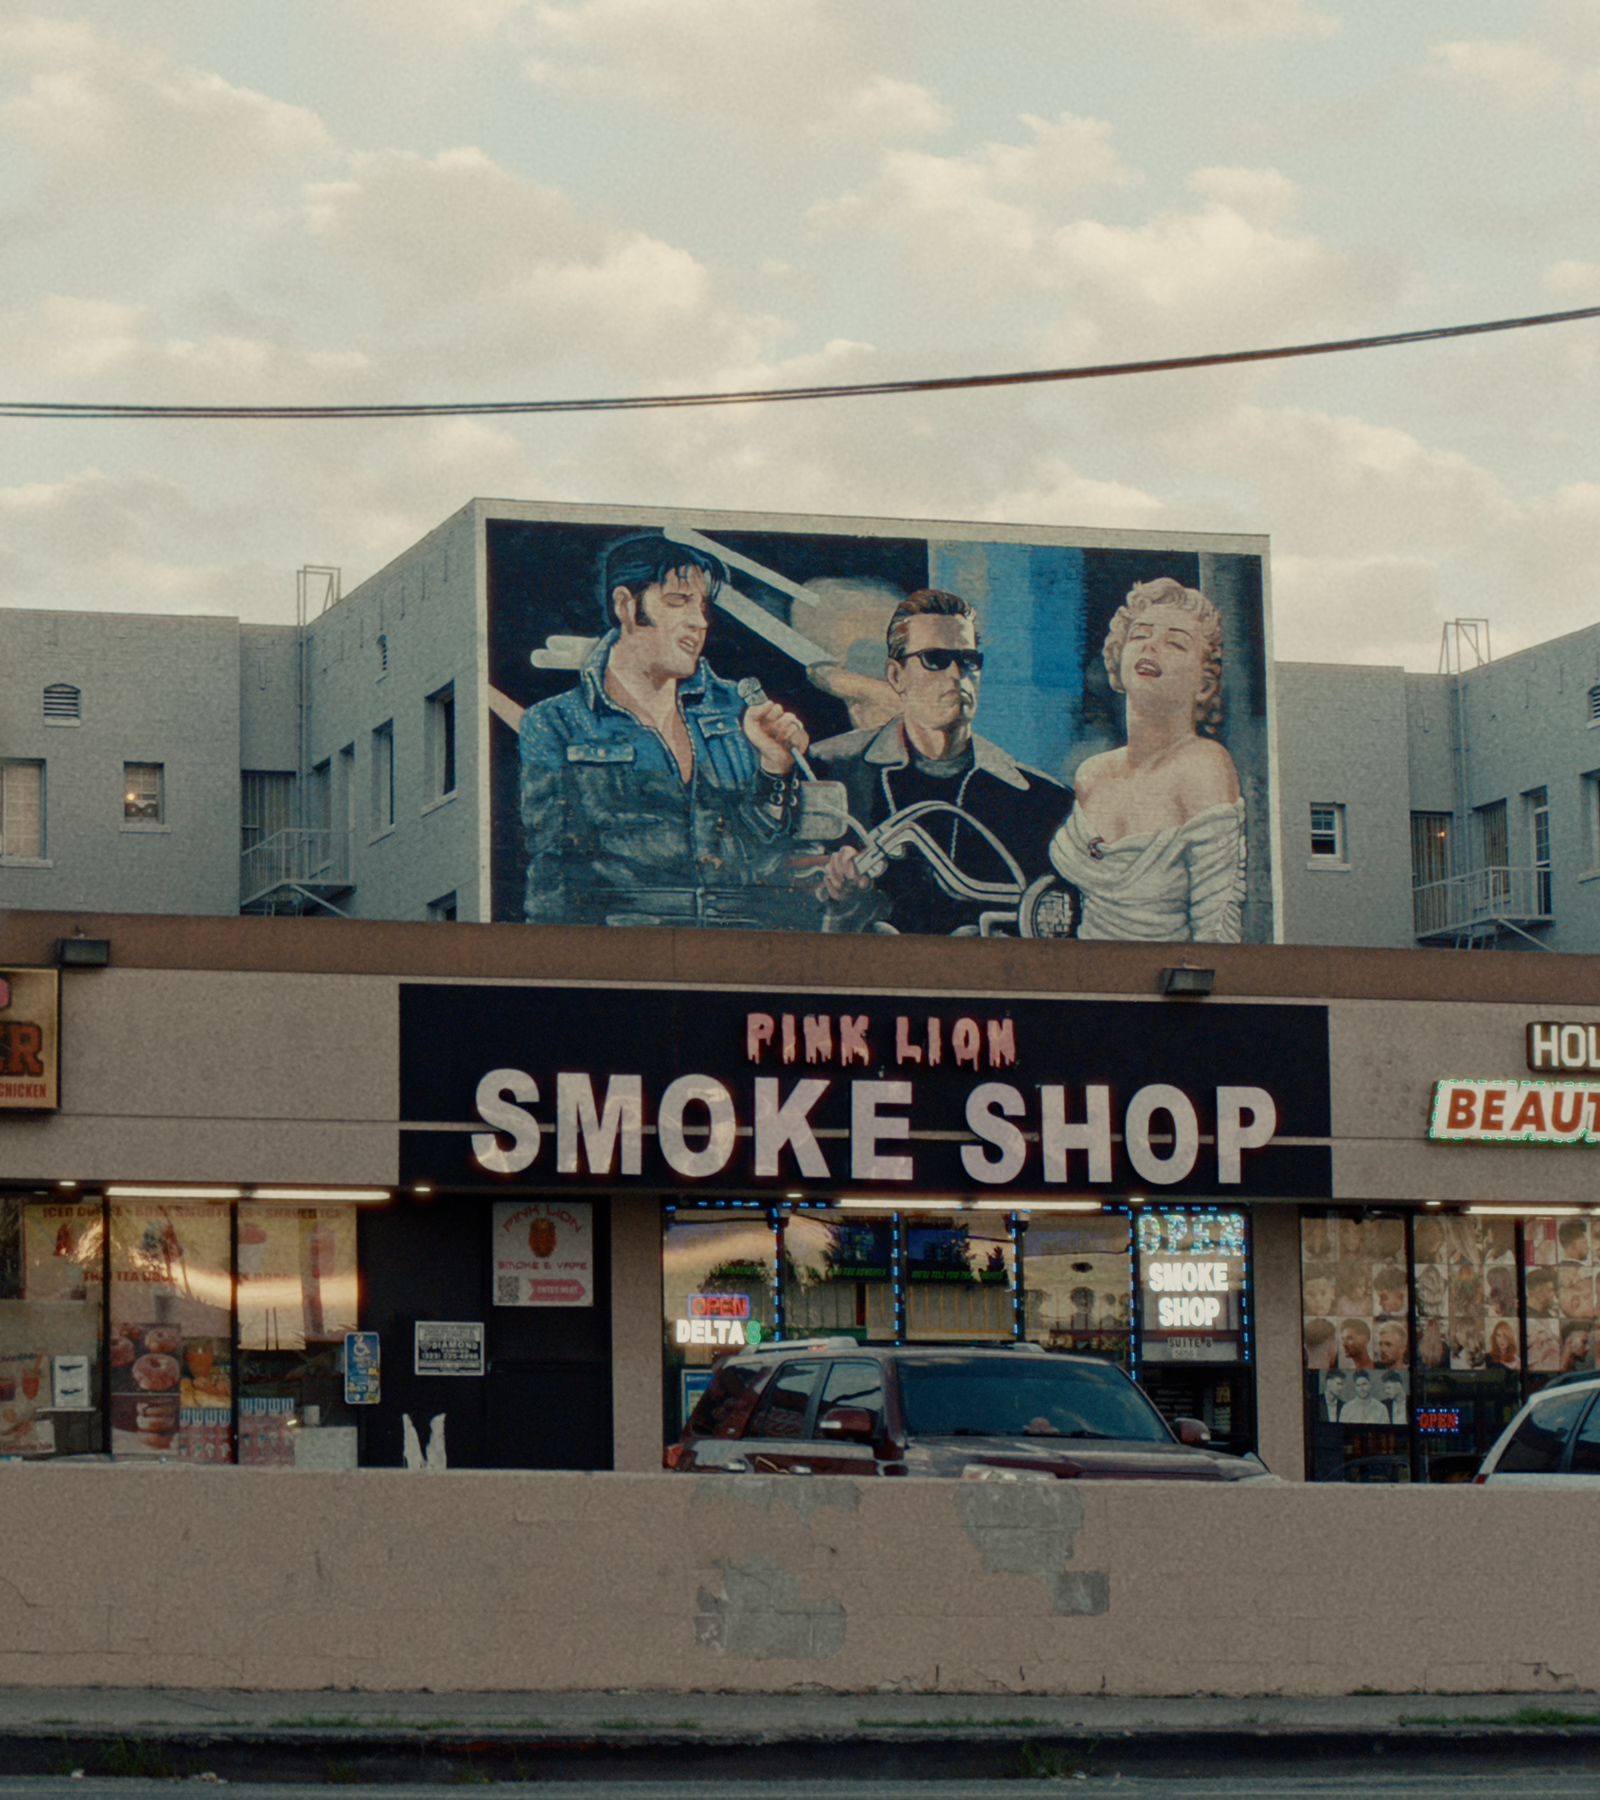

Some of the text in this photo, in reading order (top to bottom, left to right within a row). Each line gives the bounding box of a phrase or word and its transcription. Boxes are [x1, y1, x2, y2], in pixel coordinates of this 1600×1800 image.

[747, 1013, 1016, 1071] PINK LION
[471, 1067, 1277, 1185] SMOKE SHOP
[503, 1205, 582, 1233] PINK LION
[1138, 1214, 1245, 1256] OPEN
[117, 1271, 139, 1282] TEA
[498, 1261, 540, 1271] SMOKE
[557, 1261, 588, 1271] VAPE
[1148, 1262, 1229, 1292] SMOKE
[691, 1297, 747, 1317] OPEN
[1158, 1296, 1220, 1327] SHOP
[676, 1319, 761, 1345] DELTA 8
[1169, 1338, 1200, 1348] SUITE
[432, 1341, 478, 1350] DIAMOND
[1419, 1412, 1458, 1429] OPEN
